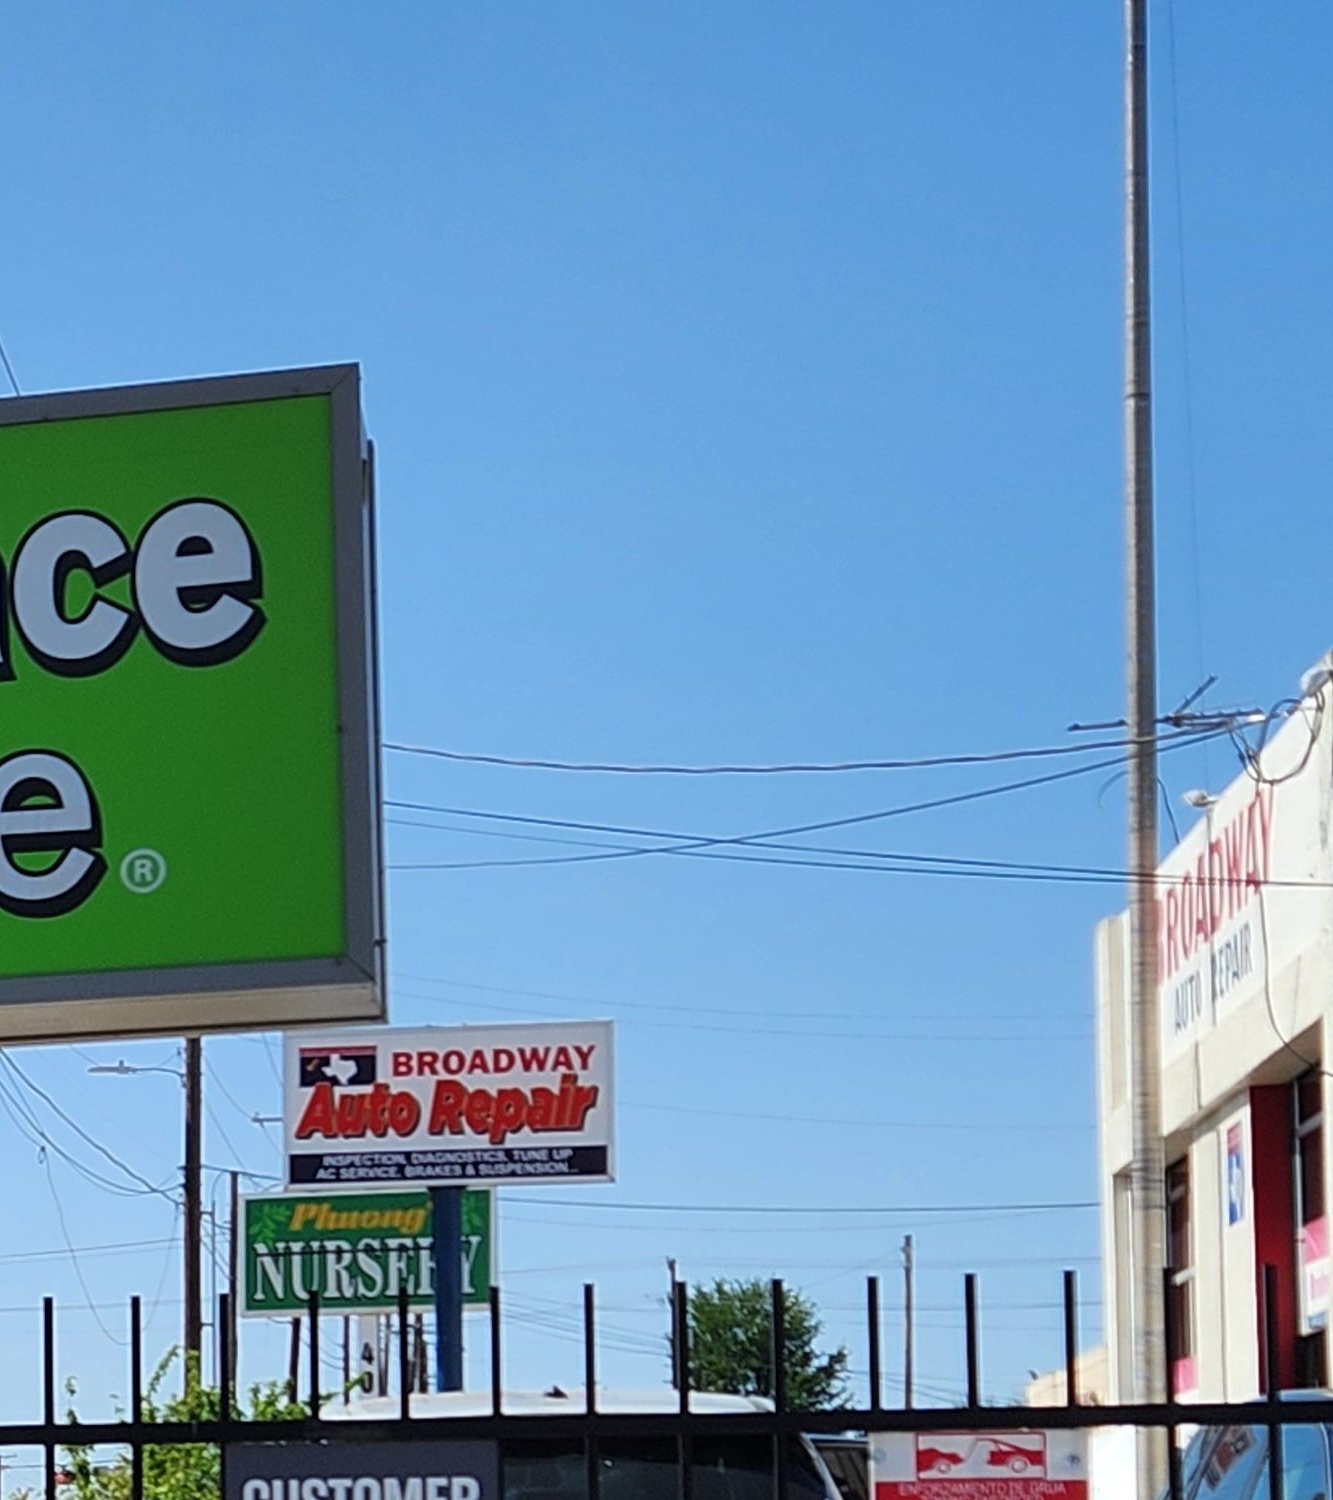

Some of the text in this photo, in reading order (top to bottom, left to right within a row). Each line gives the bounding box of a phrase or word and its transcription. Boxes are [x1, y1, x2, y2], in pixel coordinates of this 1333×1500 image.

[1175, 922, 1253, 1036] AUTO REPAIR
[392, 1044, 596, 1077] BROADWAY
[295, 1073, 599, 1145] Auto Repair
[512, 1148, 549, 1161] TUNE
[552, 1148, 574, 1160] UP
[315, 1168, 337, 1180] AC
[404, 1164, 462, 1177] BRAKES
[465, 1163, 477, 1176] &
